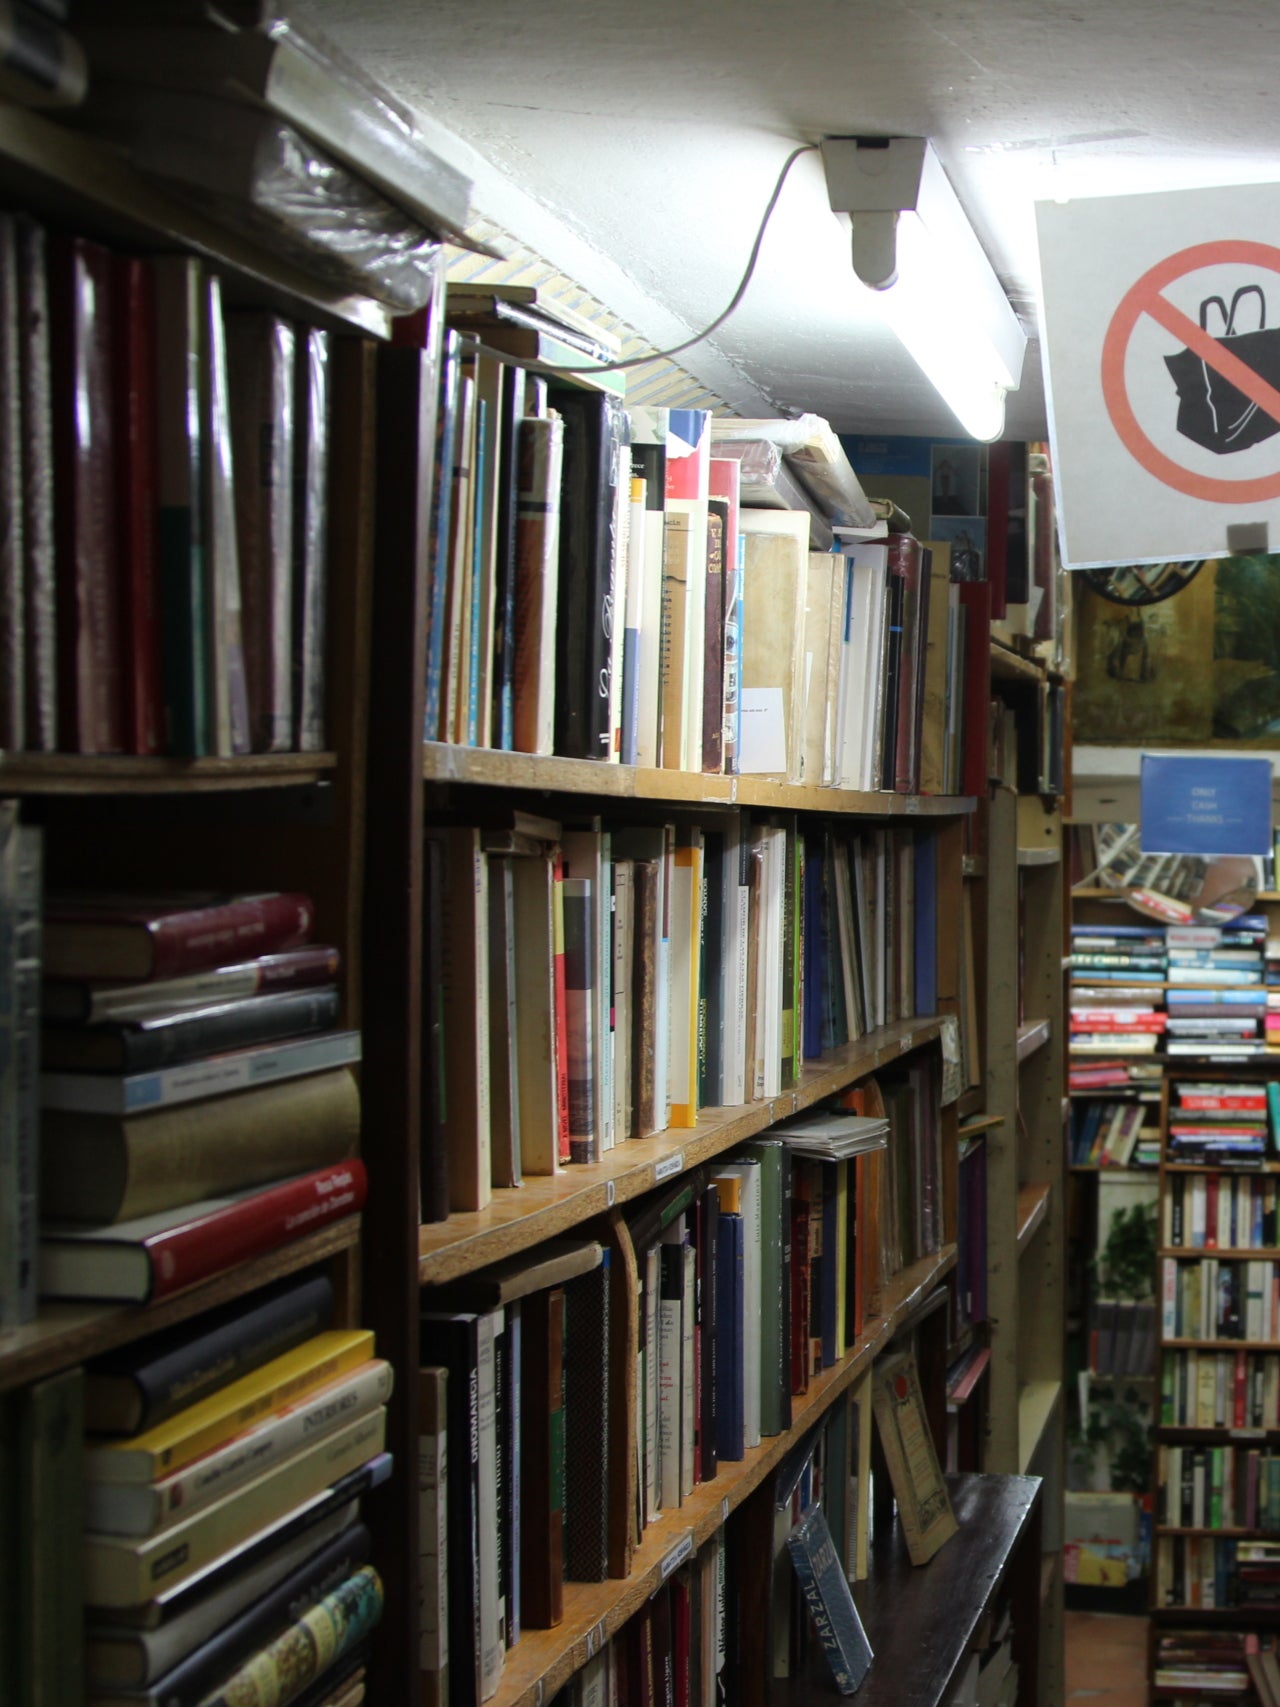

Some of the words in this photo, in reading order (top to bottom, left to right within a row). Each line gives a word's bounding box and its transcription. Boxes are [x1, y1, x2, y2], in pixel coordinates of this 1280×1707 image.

[1191, 787, 1216, 797] ONLY
[1191, 801, 1217, 810] CASH
[1186, 814, 1223, 824] THANKS
[469, 1367, 479, 1464] ONOMANCIA
[804, 1579, 837, 1650] ZARZAL
